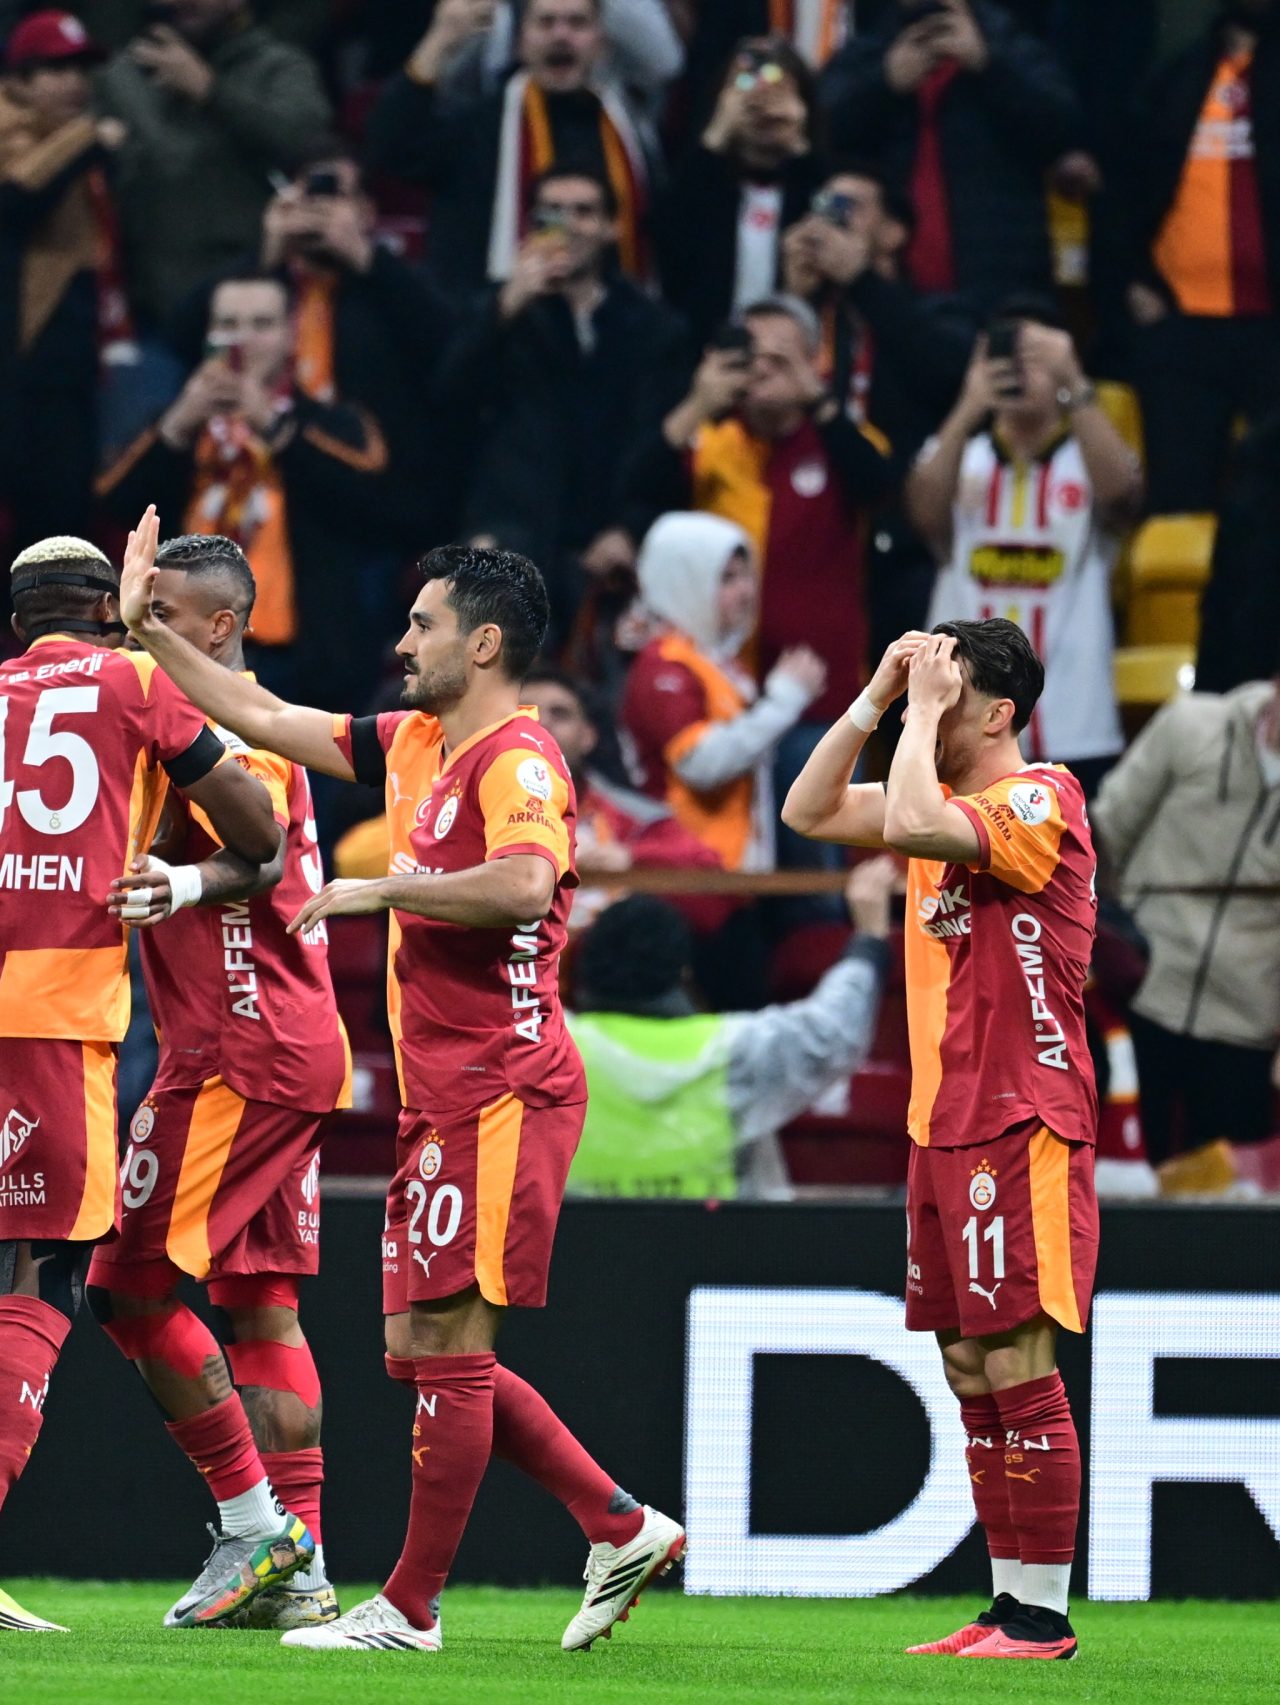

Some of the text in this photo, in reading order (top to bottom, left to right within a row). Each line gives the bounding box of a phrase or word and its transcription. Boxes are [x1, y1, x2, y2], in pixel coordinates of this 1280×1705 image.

[34, 653, 104, 682] Enerji
[972, 795, 1012, 841] ARKHAM
[221, 898, 261, 1021] ALFEM
[1011, 912, 1069, 1070] ALFEMO
[406, 1180, 463, 1247] 20
[962, 1215, 1005, 1279] 11
